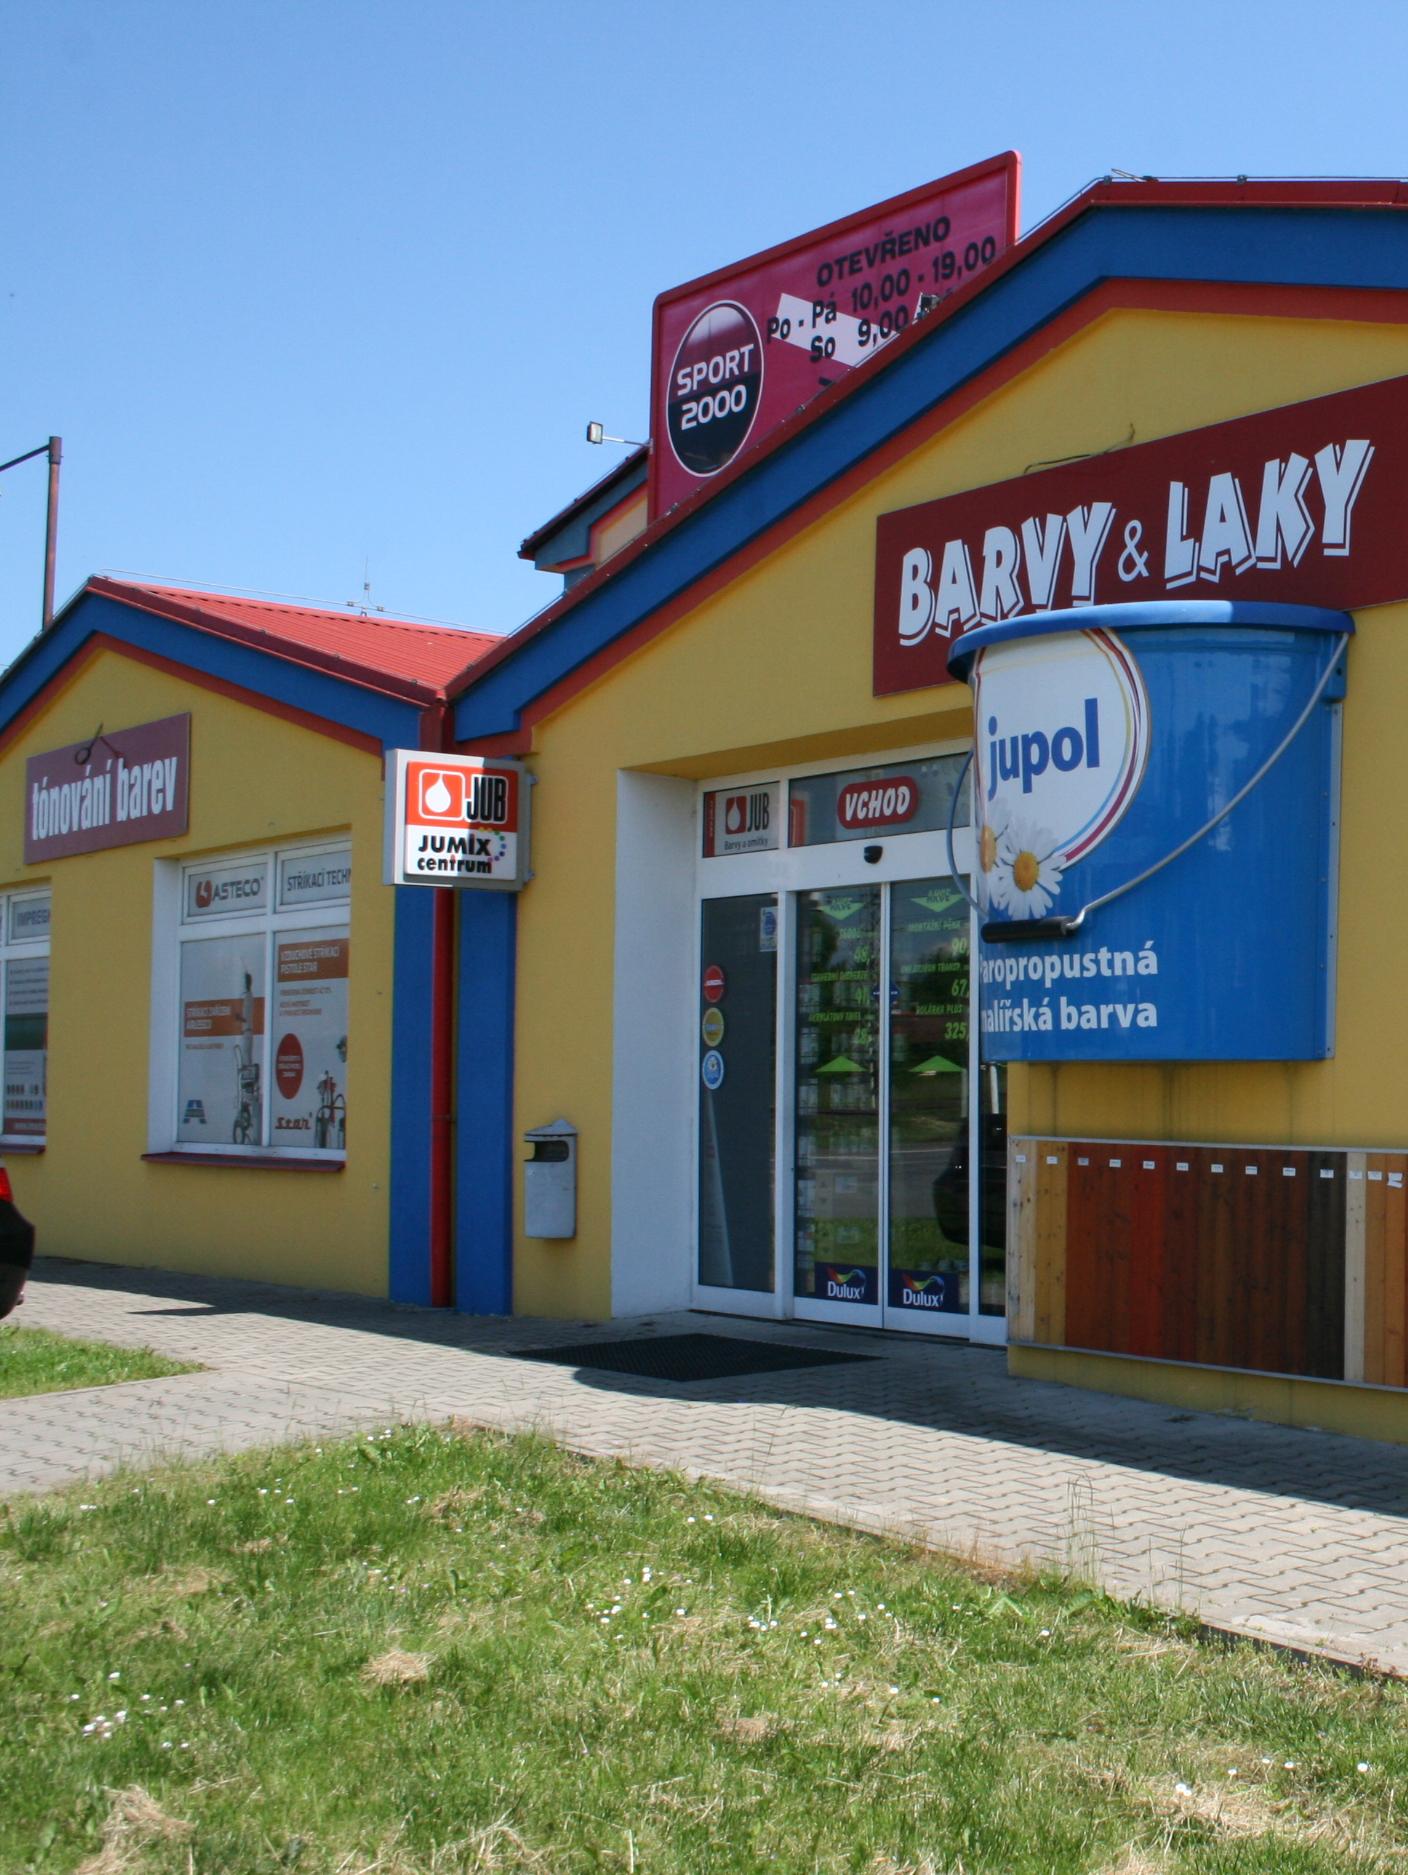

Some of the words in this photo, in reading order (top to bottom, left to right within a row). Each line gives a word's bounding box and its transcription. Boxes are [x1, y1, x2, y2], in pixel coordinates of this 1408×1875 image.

[816, 215, 951, 288] OTEVŘENO
[767, 317, 791, 343] Po
[811, 293, 837, 329] Pá
[851, 269, 910, 313] 10,00
[931, 236, 996, 283] 19,00
[677, 344, 755, 396] SPORT
[681, 385, 747, 431] 2000
[898, 501, 1117, 647] BARVY
[1117, 519, 1149, 582] &
[1164, 439, 1375, 589] LAKY
[988, 697, 1100, 801] jupol
[32, 759, 113, 840] tónování
[116, 756, 178, 823] barev
[465, 775, 508, 823] JUB
[747, 792, 770, 832] JUB
[845, 785, 910, 822] VCHOD
[417, 855, 492, 874] centrum
[1060, 996, 1158, 1030] barva
[827, 1280, 861, 1300] Dulux
[903, 1288, 939, 1308] Dulux
